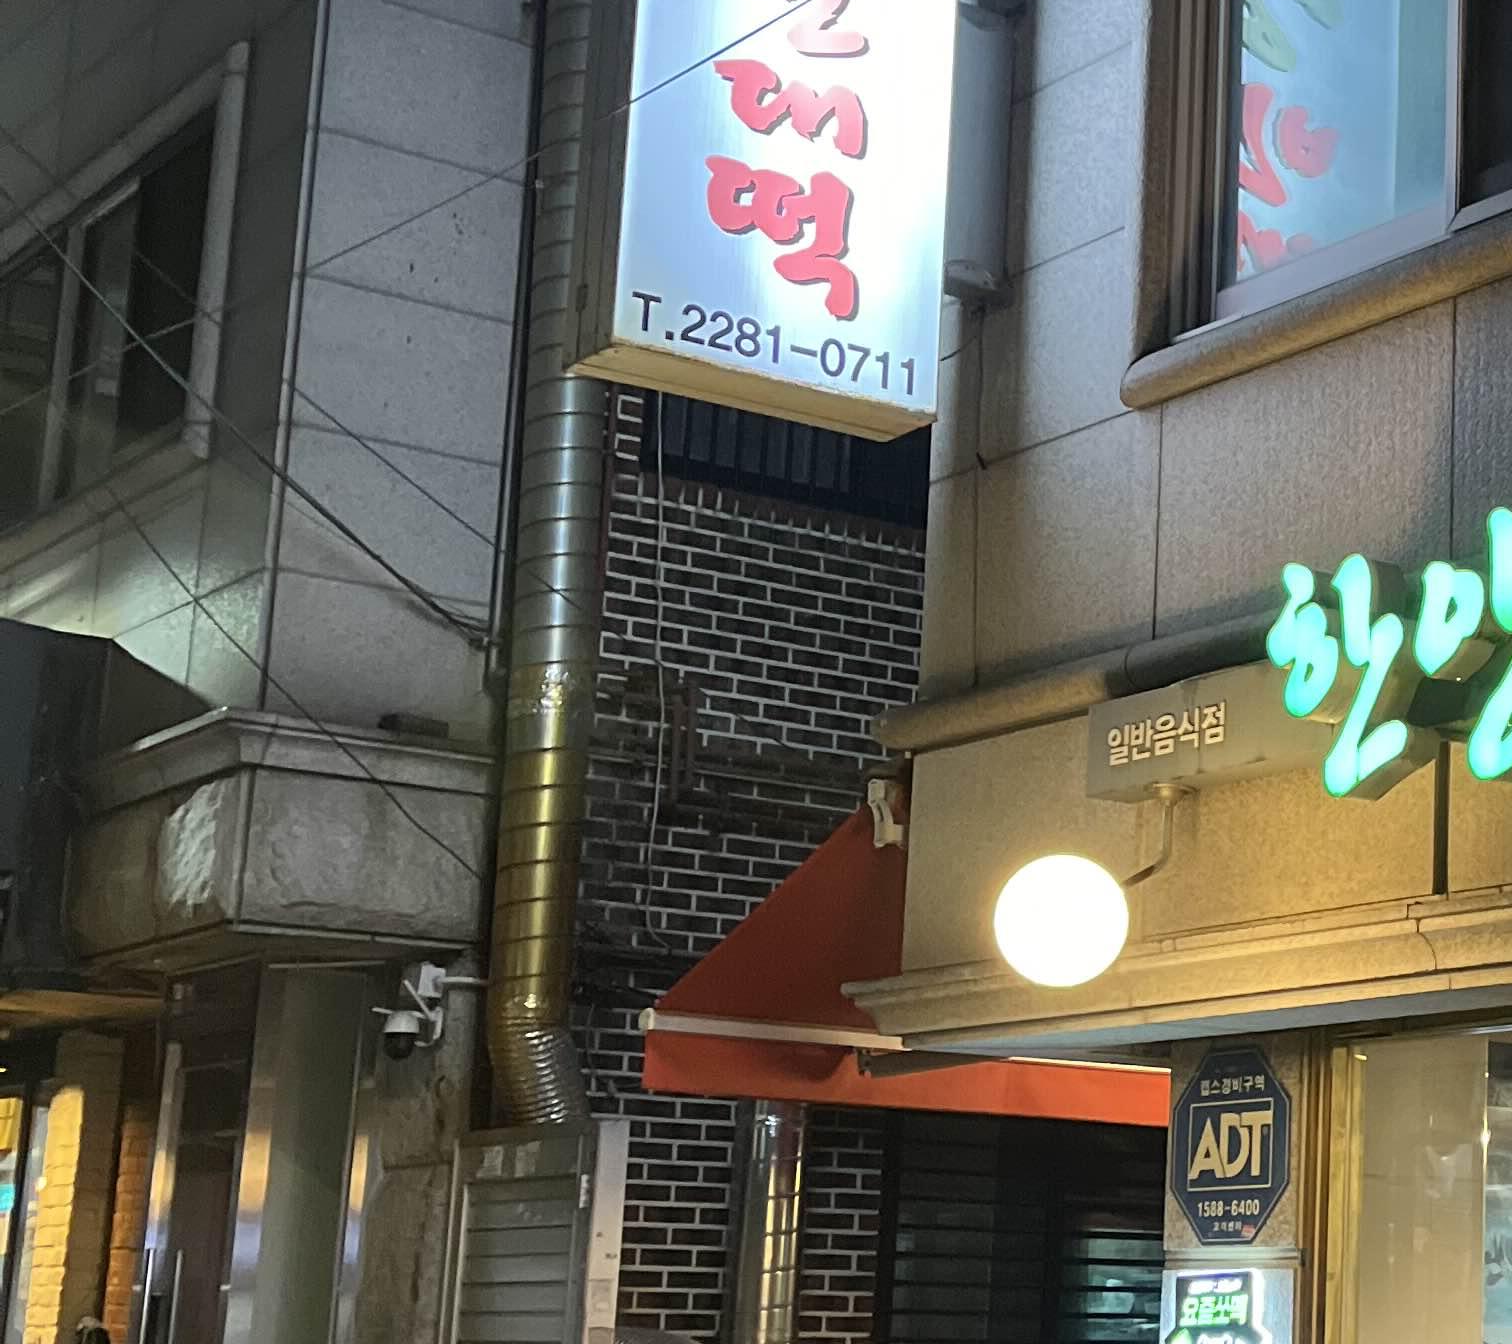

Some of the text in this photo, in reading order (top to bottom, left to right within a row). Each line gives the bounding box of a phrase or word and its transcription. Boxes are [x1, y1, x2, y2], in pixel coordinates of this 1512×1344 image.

[631, 290, 917, 397] T.2281-0711
[1107, 701, 1227, 767] 일반음식점
[1187, 1110, 1273, 1181] ADT
[1198, 1199, 1260, 1218] 1588-6400
